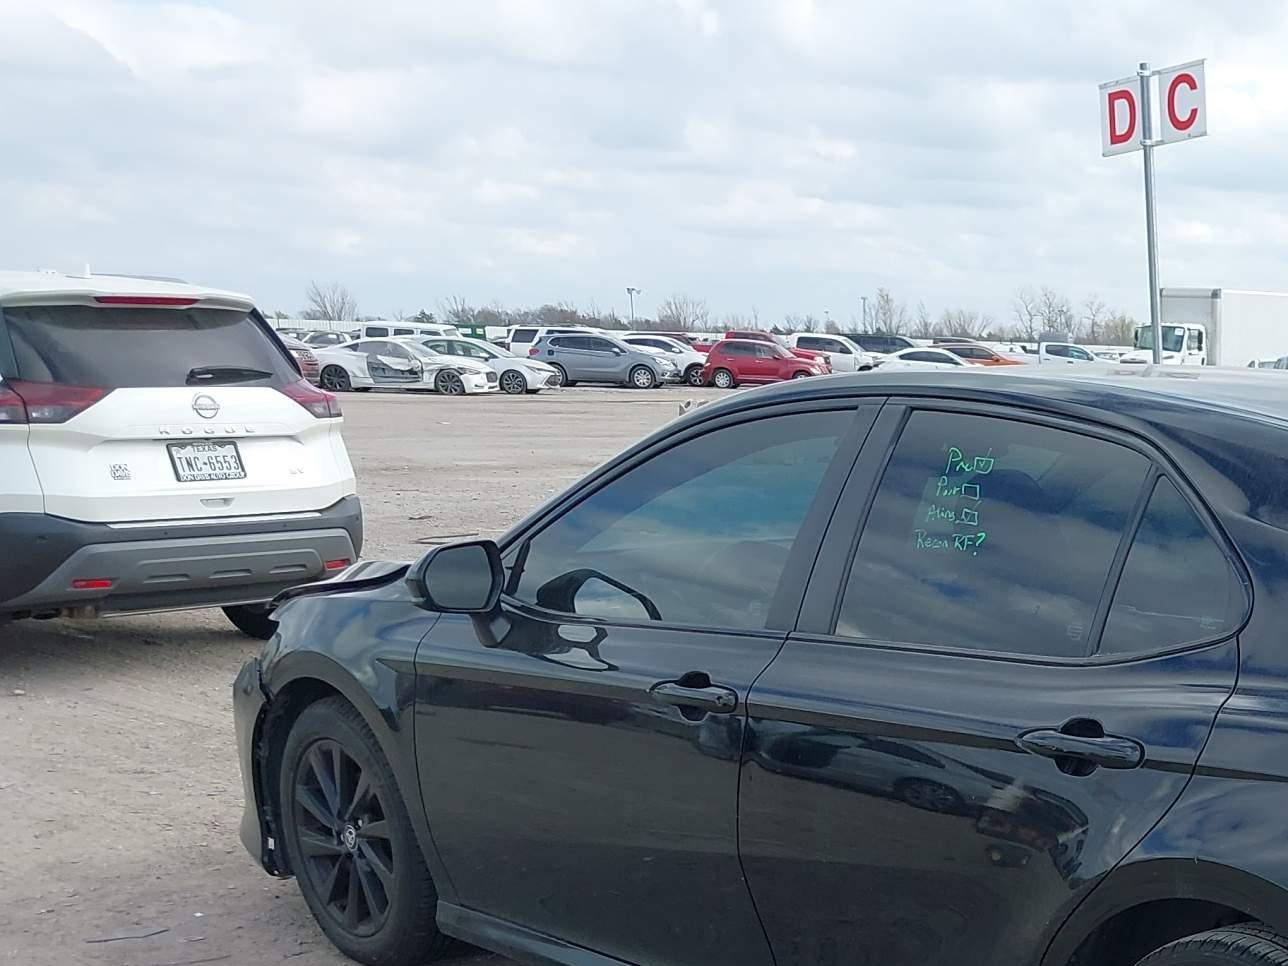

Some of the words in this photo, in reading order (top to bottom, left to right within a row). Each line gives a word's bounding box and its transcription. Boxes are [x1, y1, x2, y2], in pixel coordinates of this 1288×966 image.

[1108, 89, 1136, 145] D
[1167, 73, 1198, 131] C
[191, 445, 218, 453] TEXAS
